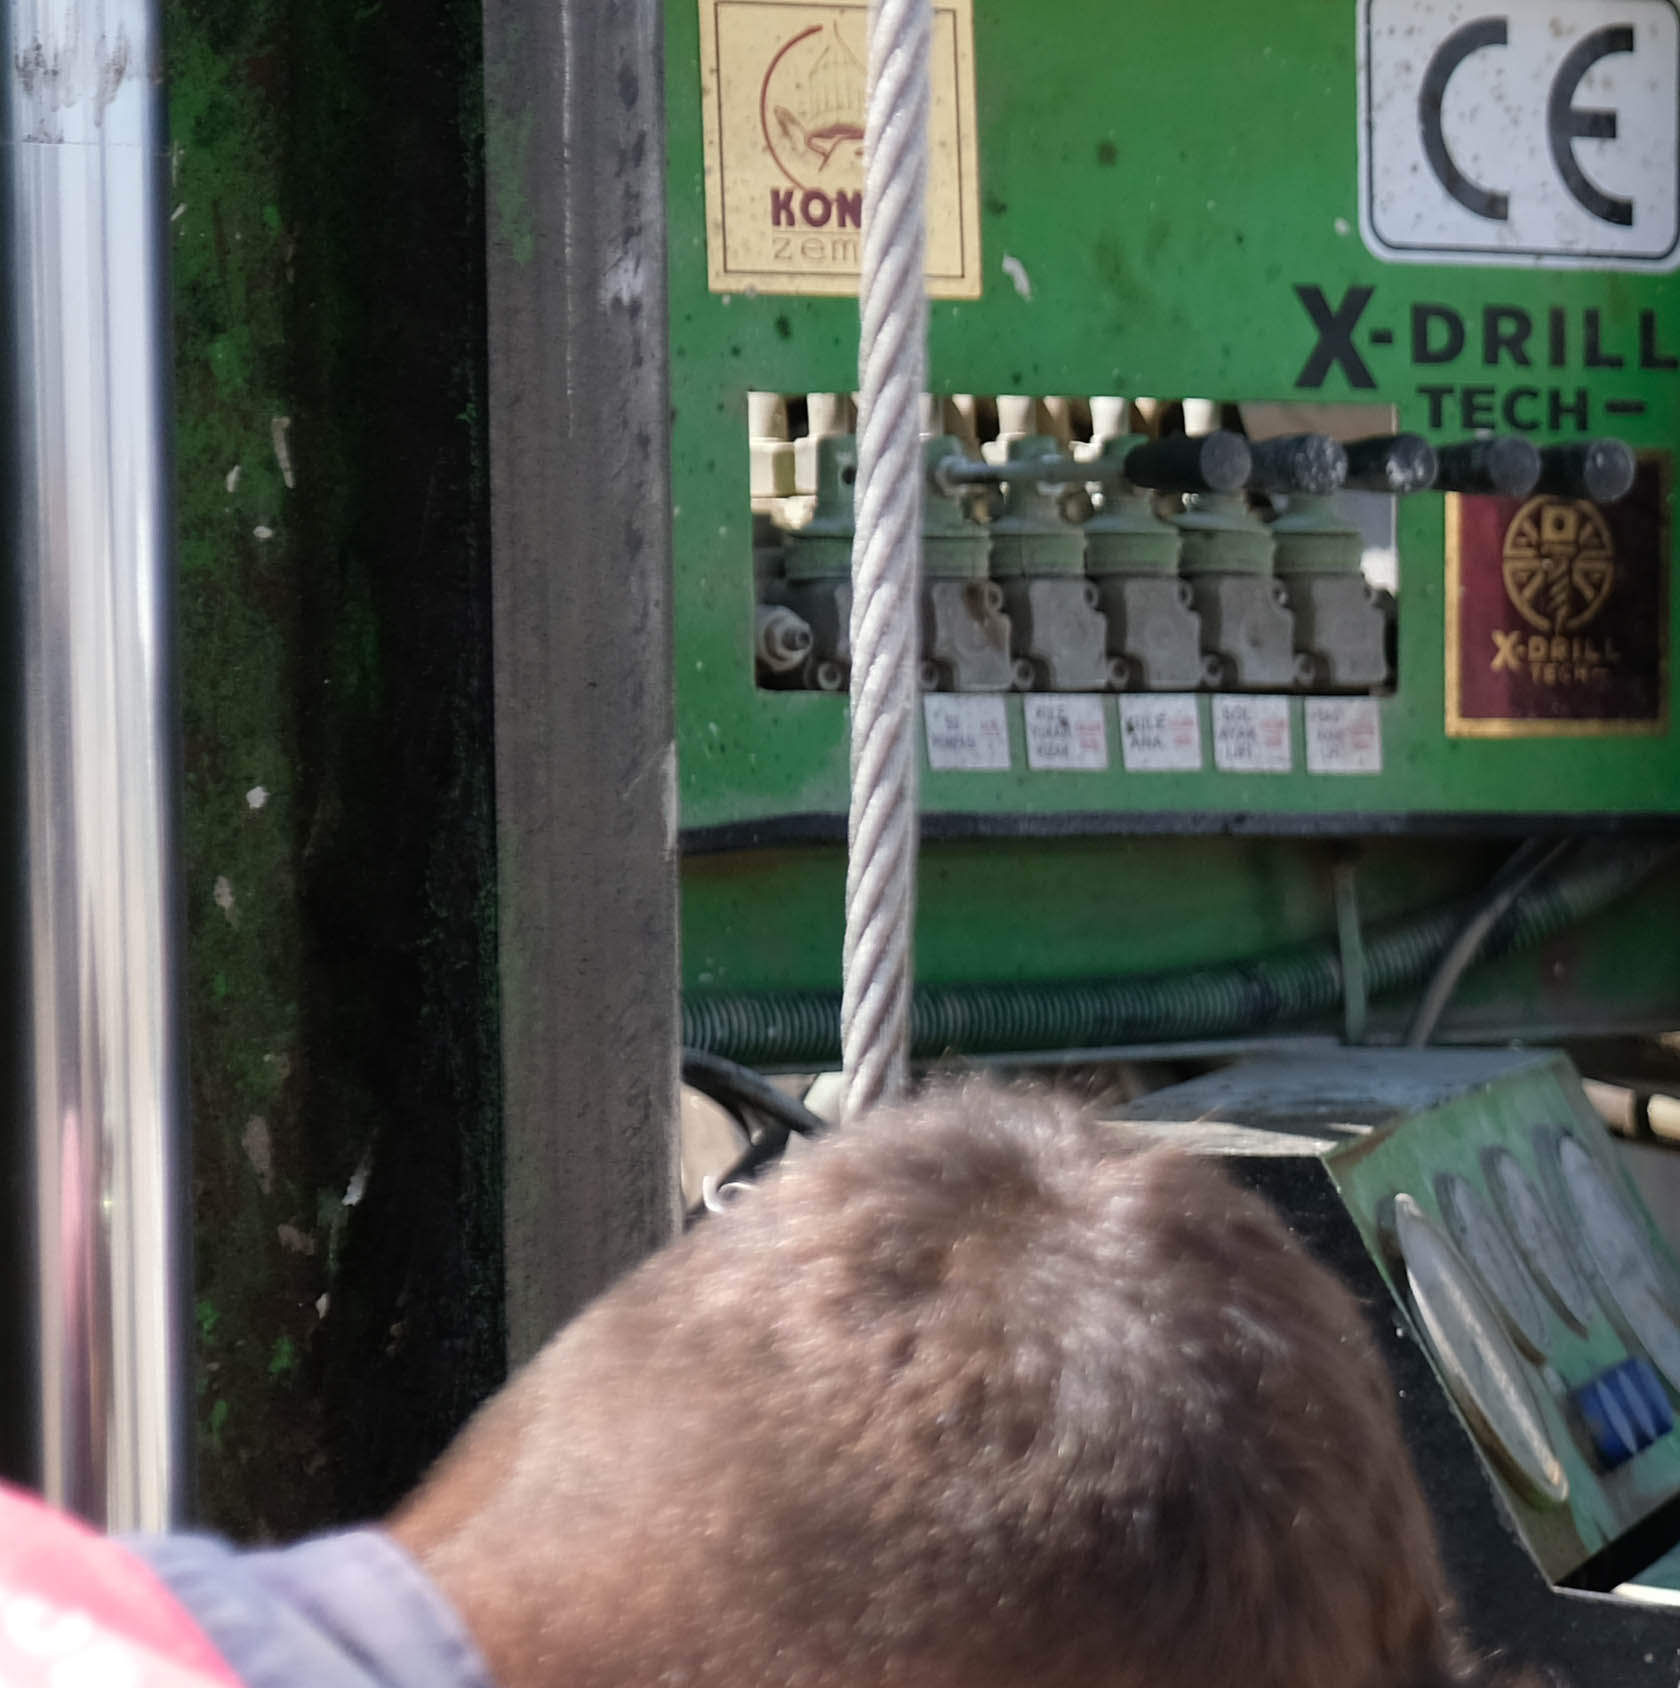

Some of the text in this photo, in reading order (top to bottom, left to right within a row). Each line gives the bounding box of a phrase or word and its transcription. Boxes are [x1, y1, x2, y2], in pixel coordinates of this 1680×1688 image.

[1417, 15, 1635, 227] CE
[770, 187, 863, 229] KON
[772, 236, 859, 262] zem
[1292, 284, 1680, 390] X-DRILL
